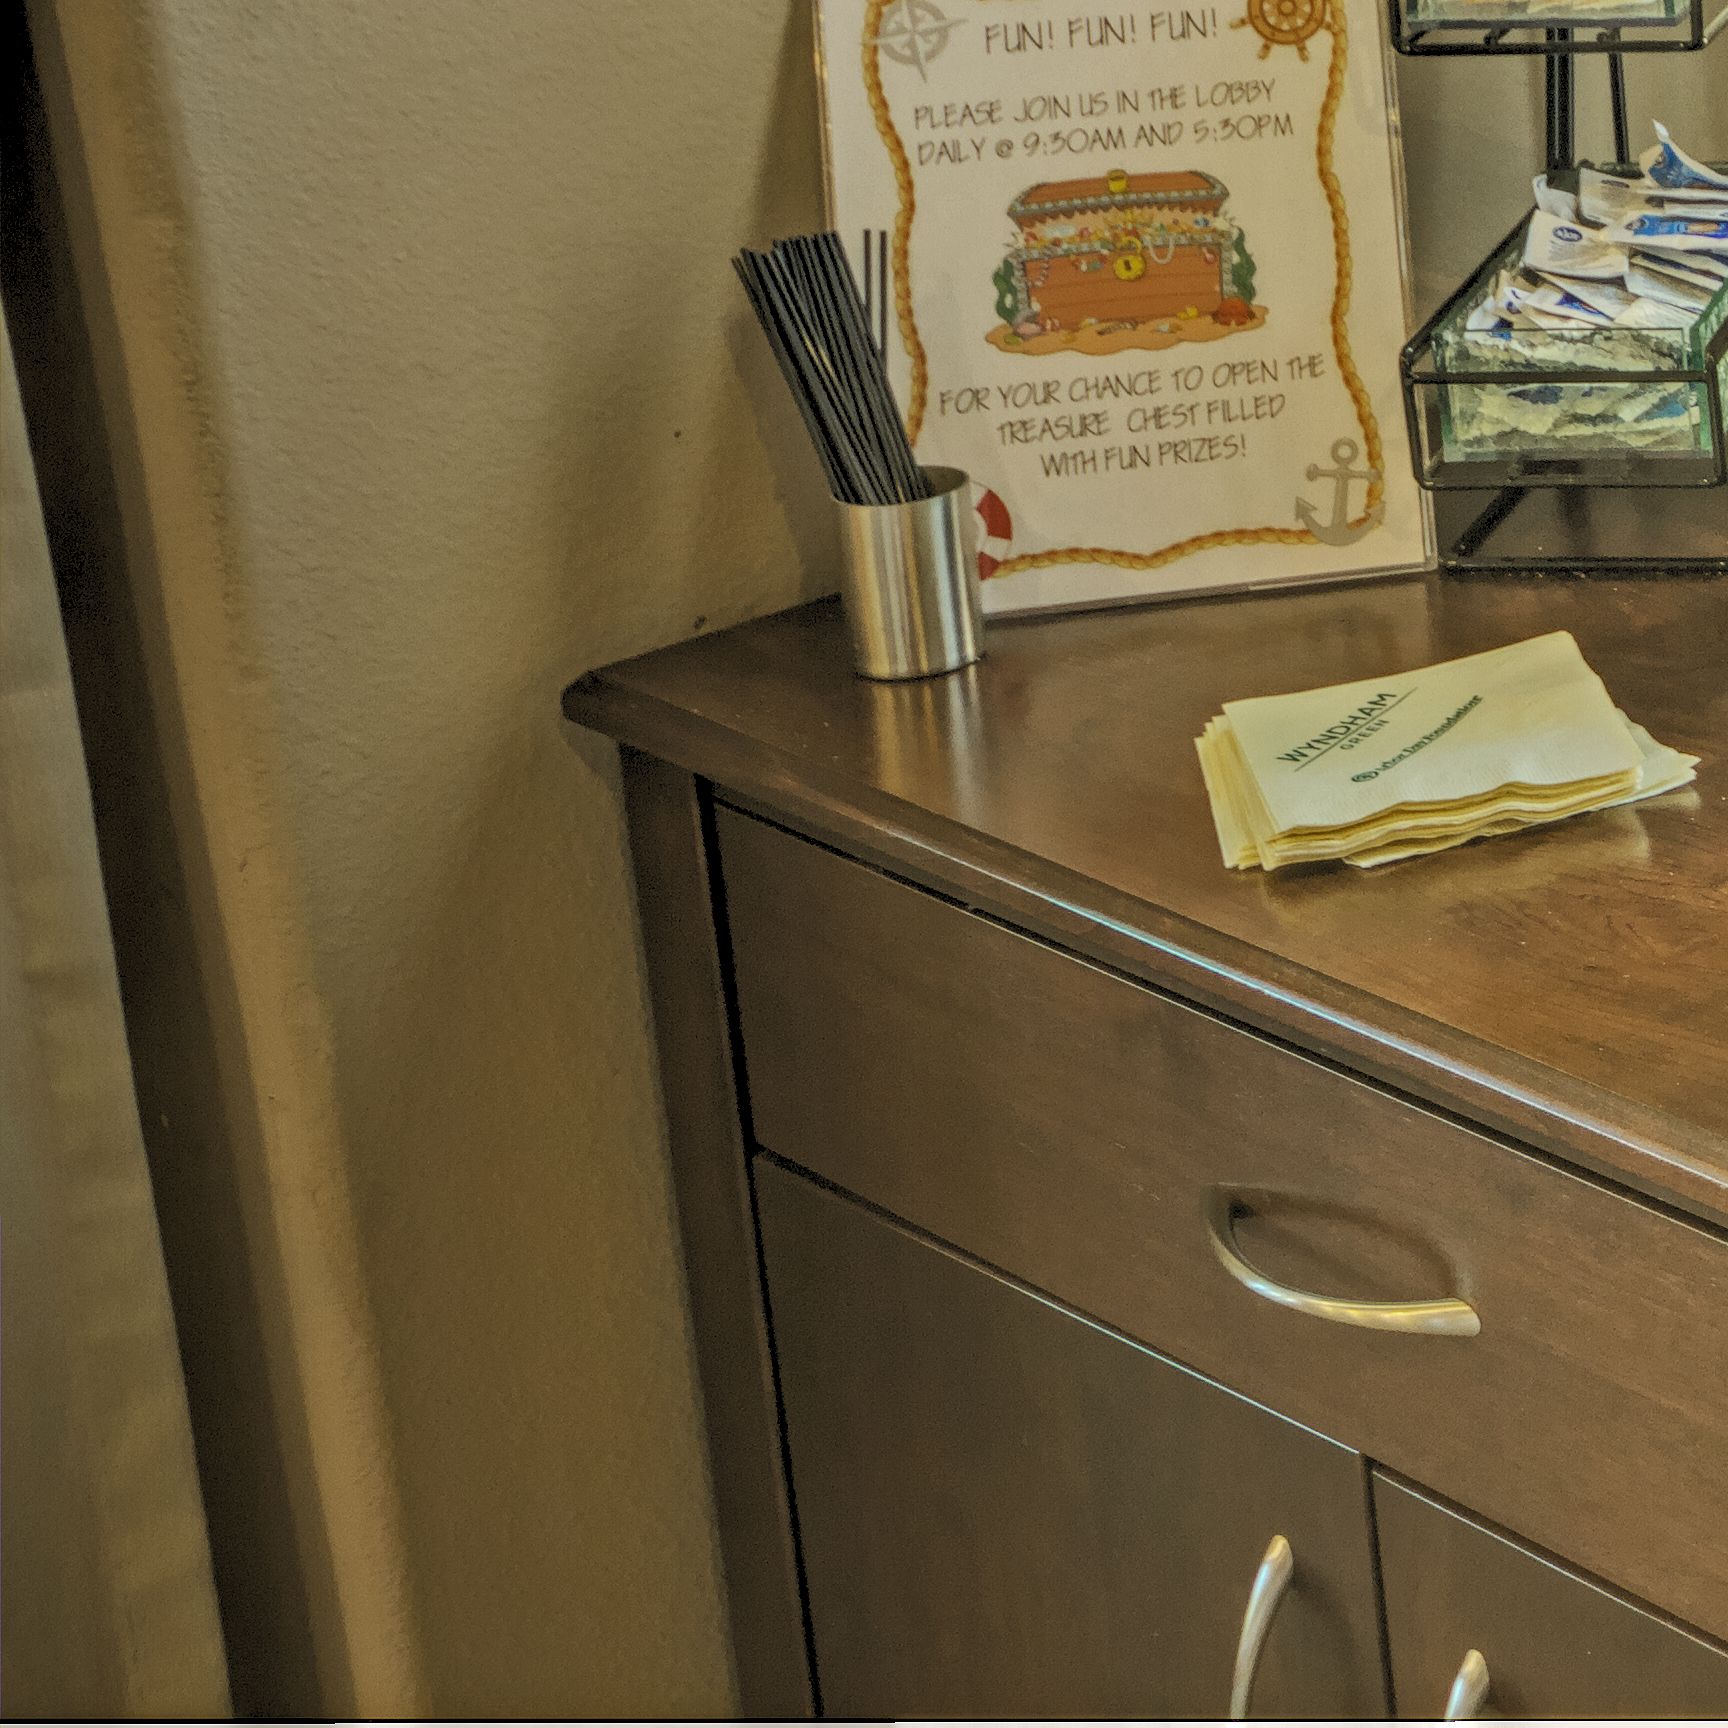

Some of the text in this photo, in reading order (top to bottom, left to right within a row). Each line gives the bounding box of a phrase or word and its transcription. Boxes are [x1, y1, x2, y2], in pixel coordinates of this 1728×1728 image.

[984, 7, 1218, 55] FUN! FUN! FUN!
[914, 78, 1276, 130] PLEASE JOIN US IN THE LOBBY
[917, 113, 1293, 166] DAILY @ 9:30AM AND 5:30PM
[939, 353, 1324, 415] FOR YOUR CHANCE TO OPEN THE
[996, 393, 1286, 445] TREASURE CHEST FILLED
[1041, 434, 1247, 478] WITH FUN PRIZES!
[1276, 693, 1398, 763] WYNDHAM
[1339, 719, 1390, 750] GREEN
